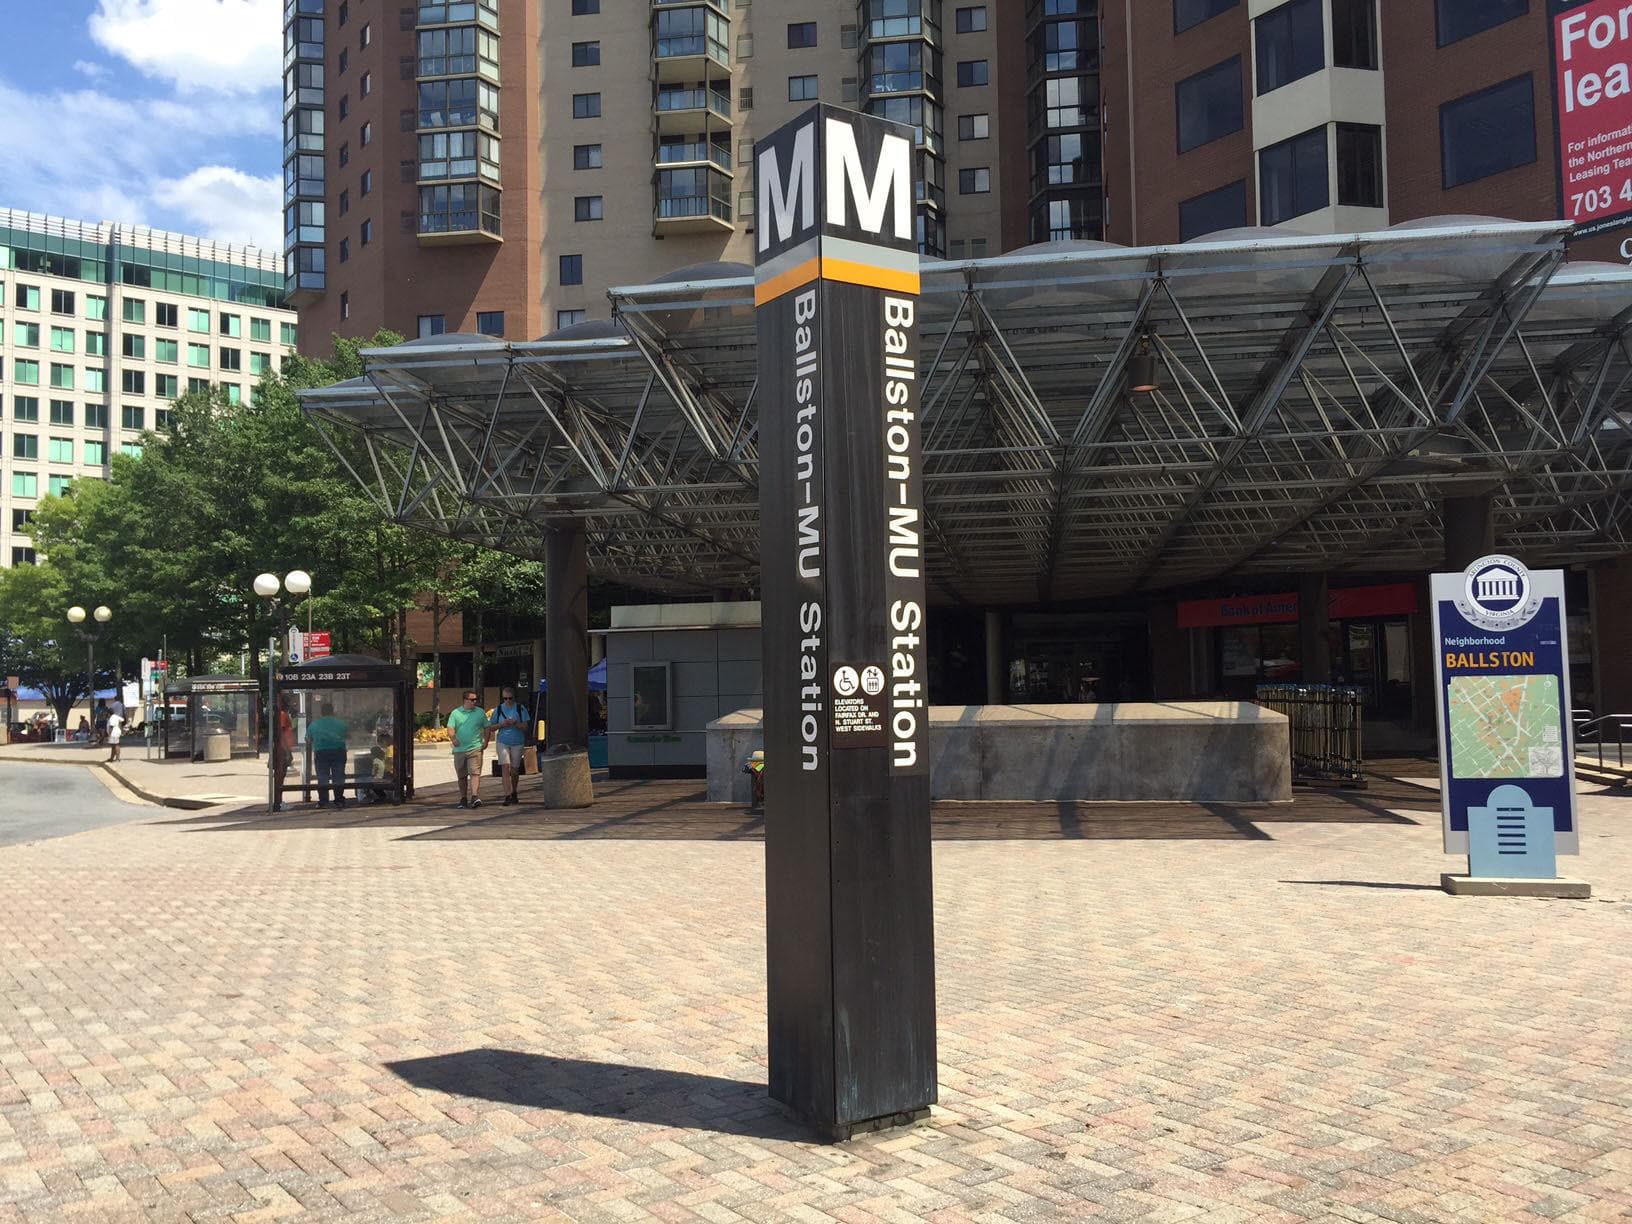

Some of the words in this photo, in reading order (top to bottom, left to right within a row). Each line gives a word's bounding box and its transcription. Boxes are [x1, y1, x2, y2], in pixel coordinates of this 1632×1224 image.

[1561, 4, 1632, 62] For
[1564, 62, 1630, 112] lea
[1567, 140, 1585, 154] For
[1568, 156, 1585, 168] the
[825, 117, 912, 241] M
[1569, 163, 1610, 183] Leasing
[758, 121, 815, 253] M
[1571, 185, 1613, 216] 703
[1221, 603, 1249, 617] Bank
[1252, 602, 1263, 615] of
[1444, 637, 1505, 648] Neighborhood
[1446, 651, 1534, 668] BALLSTON
[301, 673, 316, 681] 23A
[799, 601, 822, 771] Station
[890, 599, 923, 767] Station
[853, 724, 882, 732] SIDEWALKS
